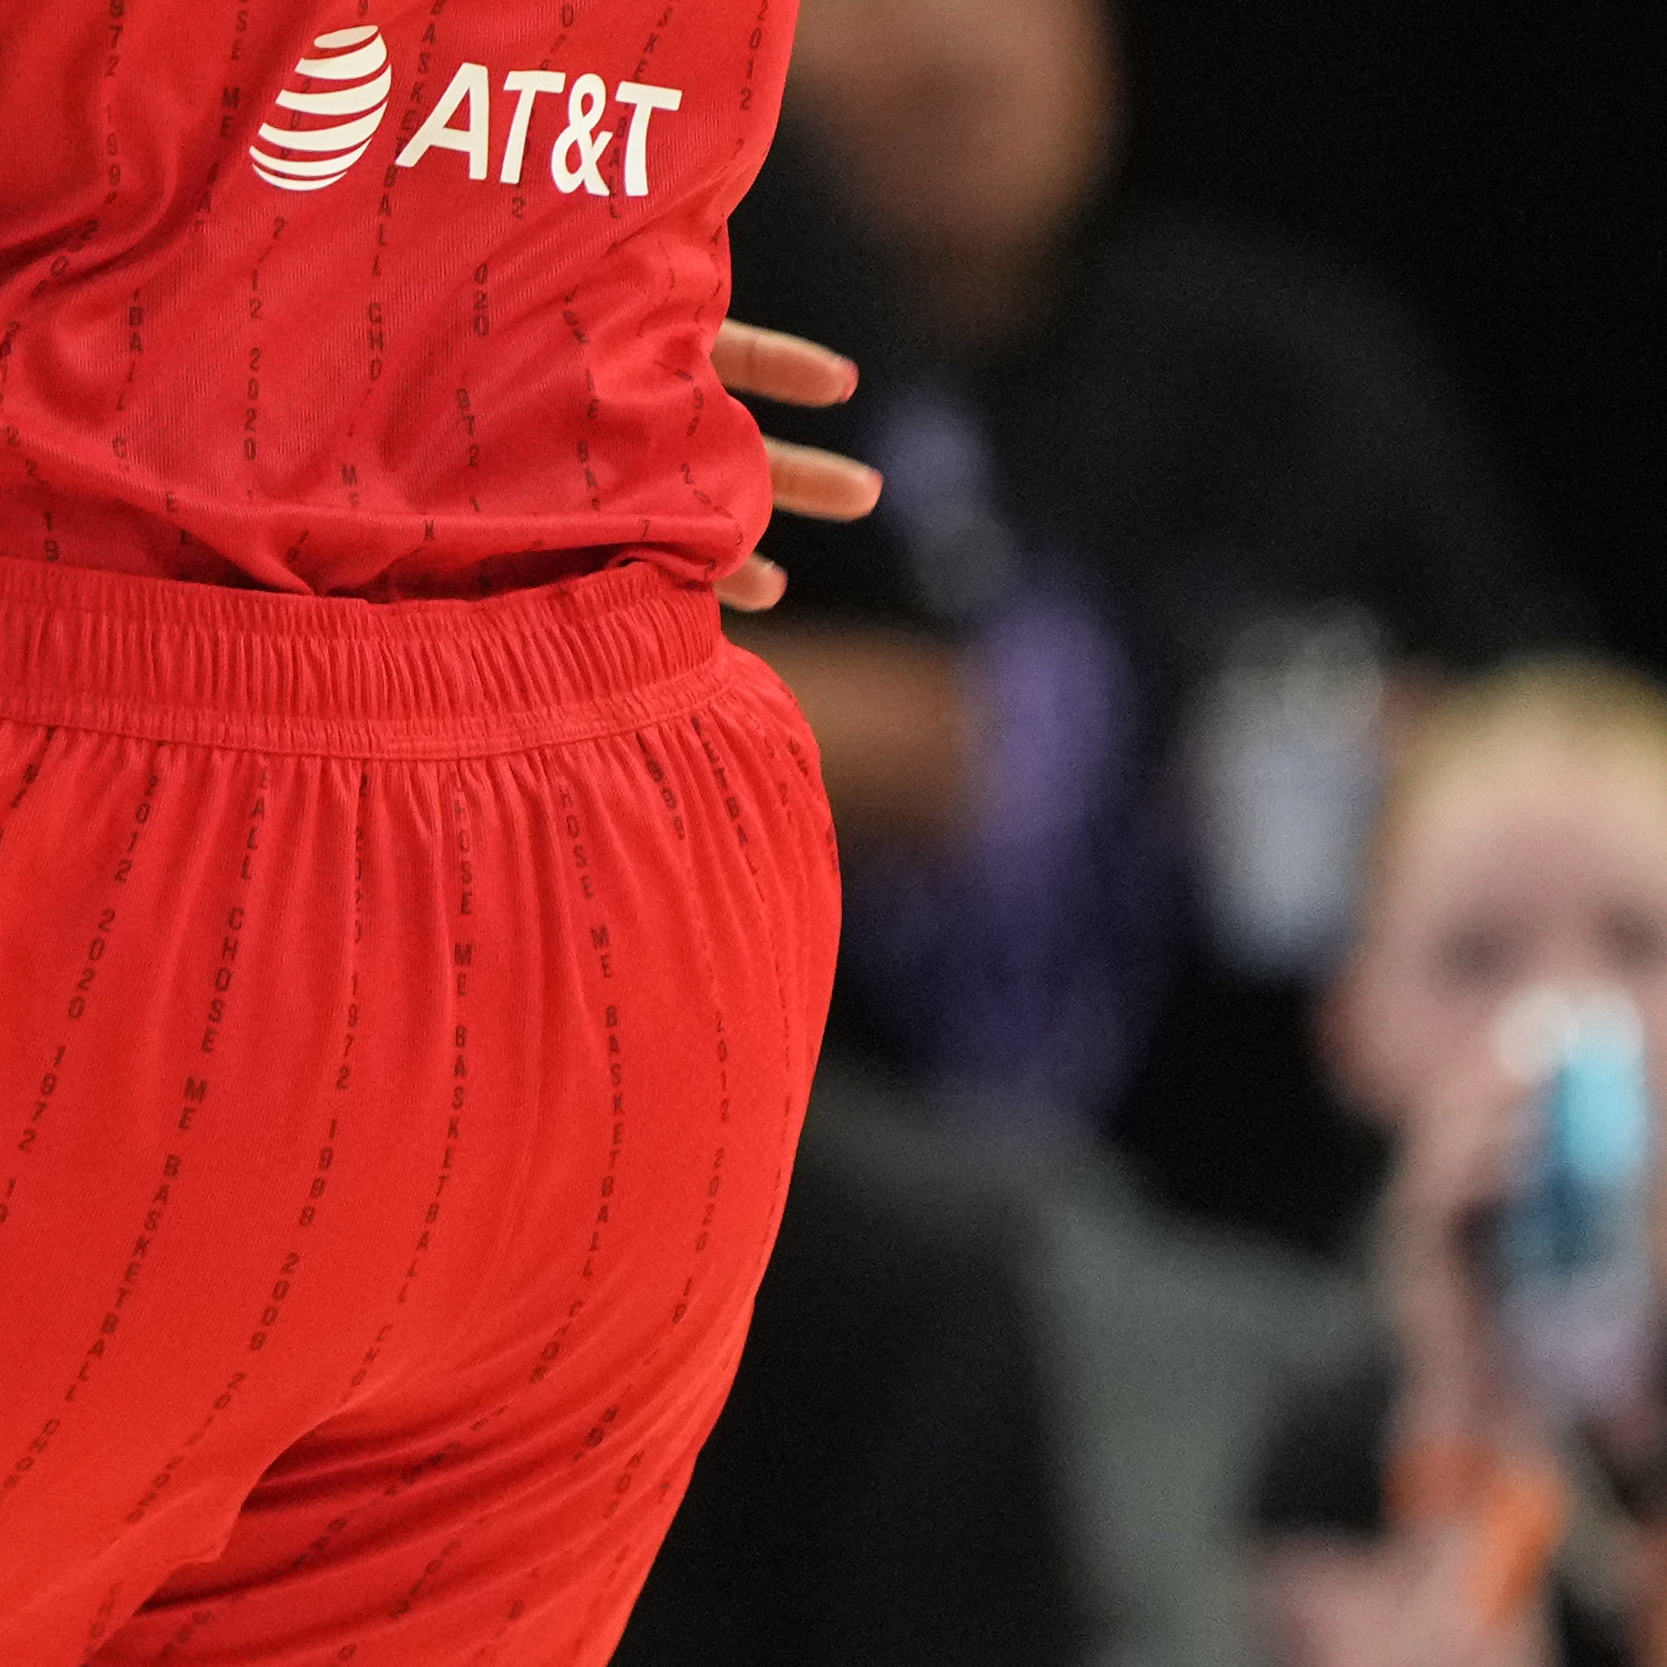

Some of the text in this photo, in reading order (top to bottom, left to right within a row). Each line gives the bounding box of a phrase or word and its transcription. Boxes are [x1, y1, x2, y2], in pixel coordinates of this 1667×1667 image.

[394, 61, 683, 198] AT&T
[243, 349, 262, 461] 2020
[113, 773, 161, 883] 2012
[66, 909, 117, 1021] 2020
[201, 905, 246, 1055] CHOSE
[335, 971, 359, 1091] 1972
[18, 1044, 67, 1155] 1972
[178, 1077, 208, 1132] ME
[580, 1004, 623, 1279] BASKETBALL
[298, 1117, 339, 1229] 1999
[396, 1024, 466, 1304] BASKETBALL
[66, 1153, 182, 1403] BASKETBALL
[249, 1251, 300, 1352] 2009
